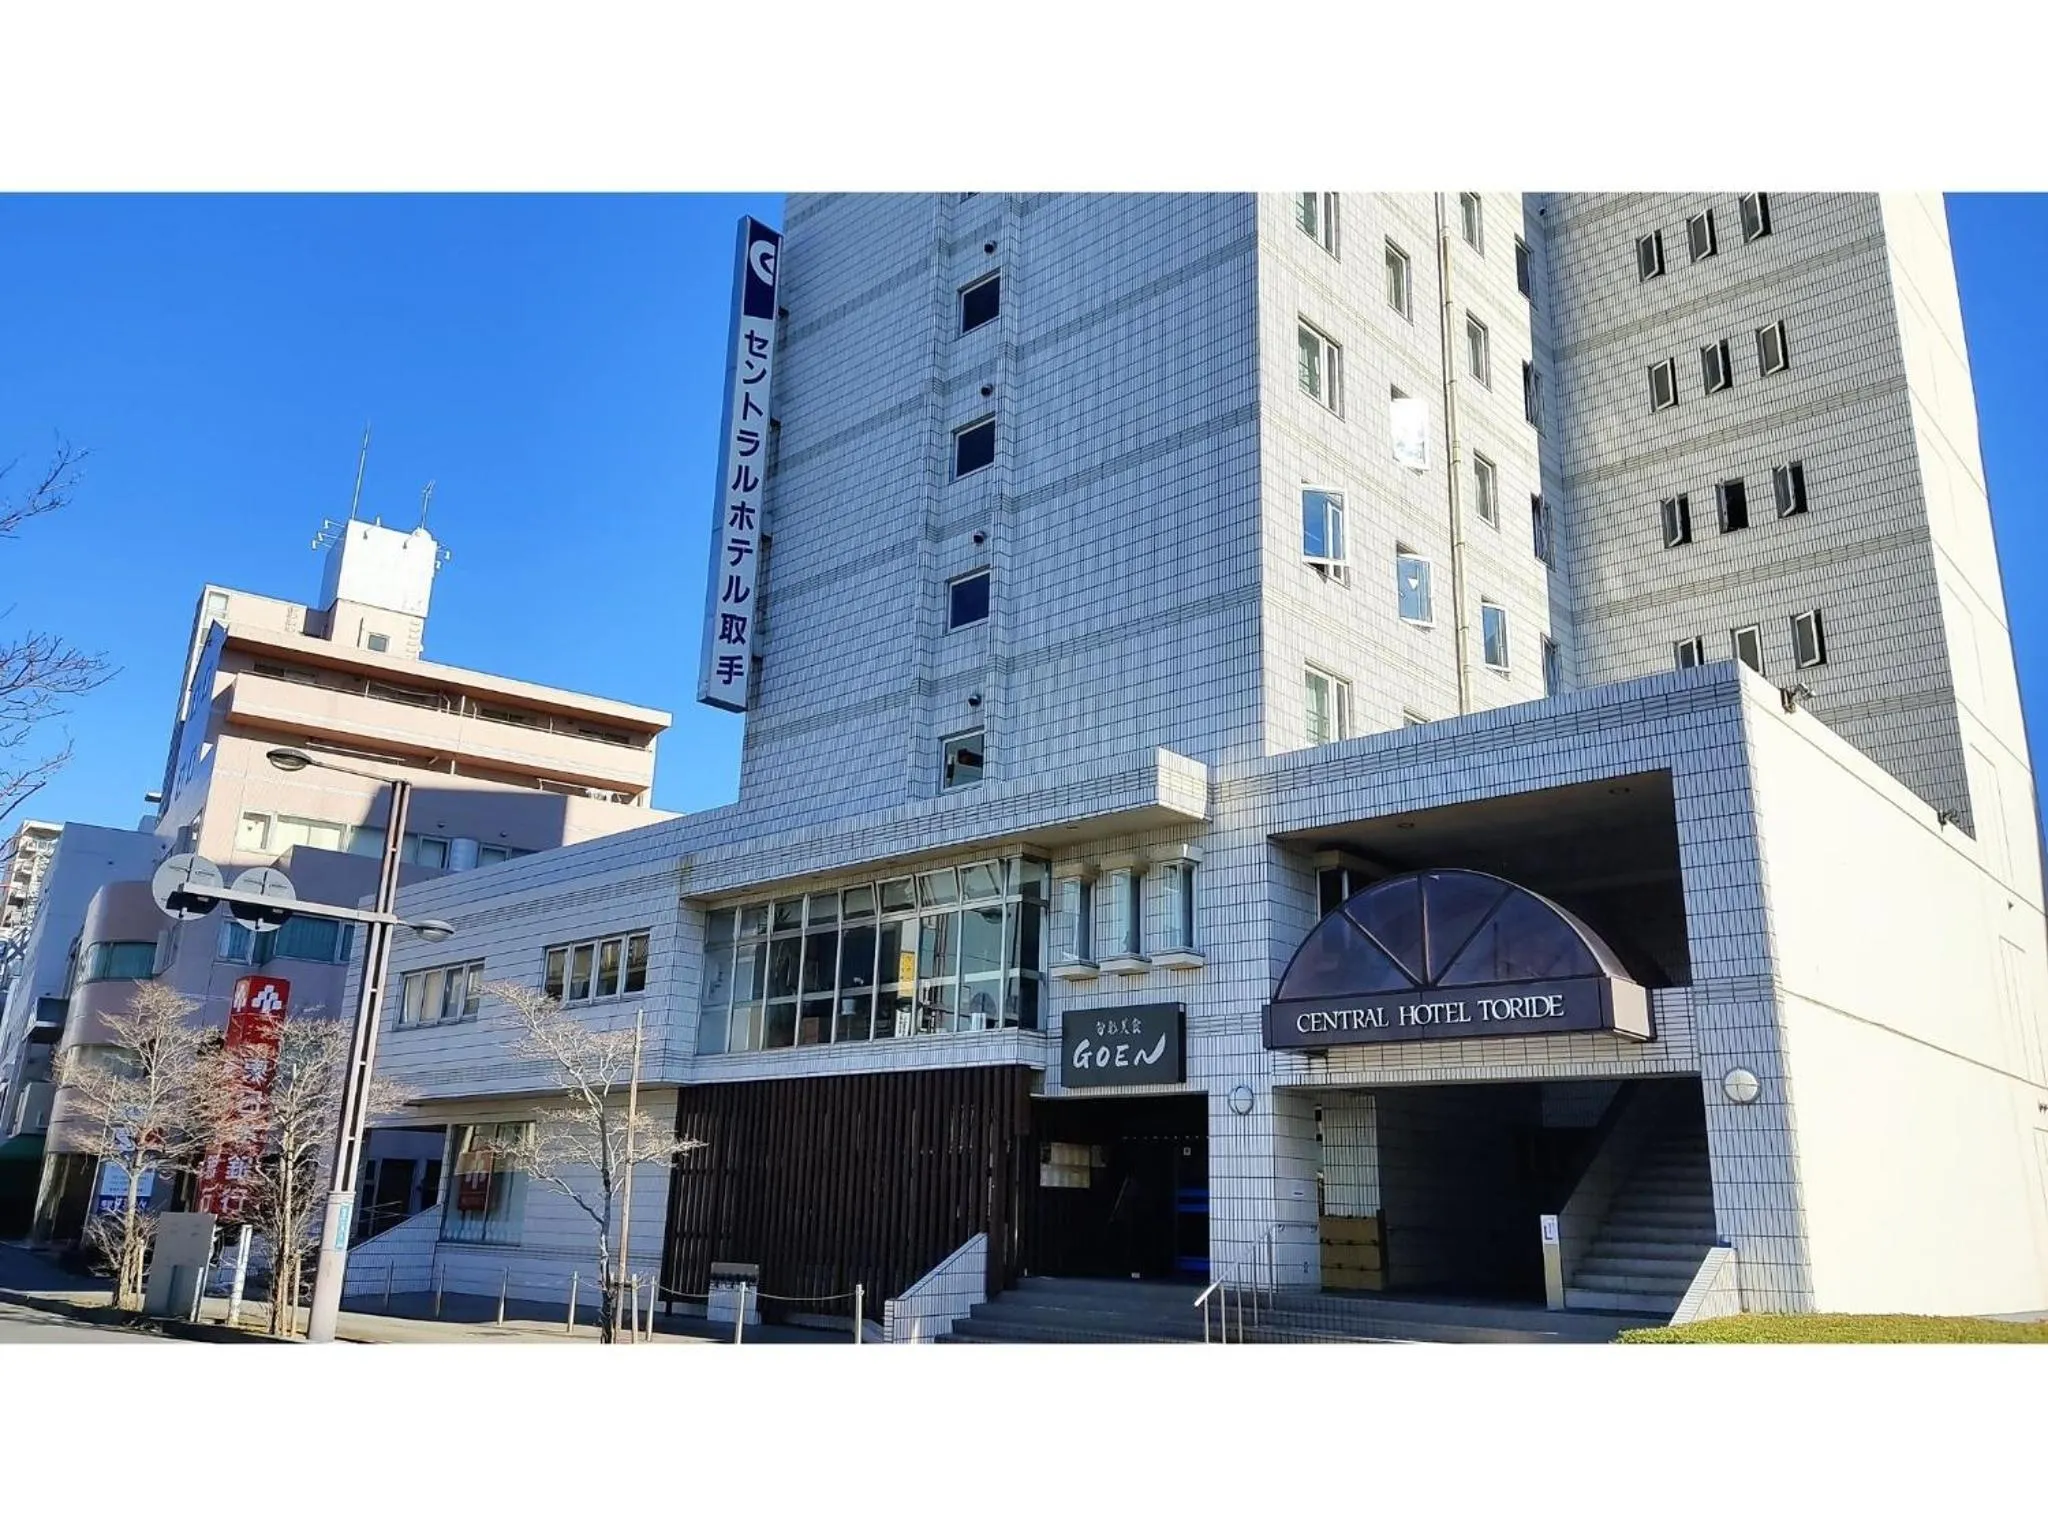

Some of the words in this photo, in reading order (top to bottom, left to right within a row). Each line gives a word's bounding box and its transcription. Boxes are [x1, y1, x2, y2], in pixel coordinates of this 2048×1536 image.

[715, 329, 769, 685] セントラルホテル取手
[1296, 1007, 1389, 1033] CENTRAL
[1399, 1001, 1471, 1026] HOTEL
[1477, 994, 1565, 1021] TORIDE
[1072, 1032, 1166, 1069] GOEN
